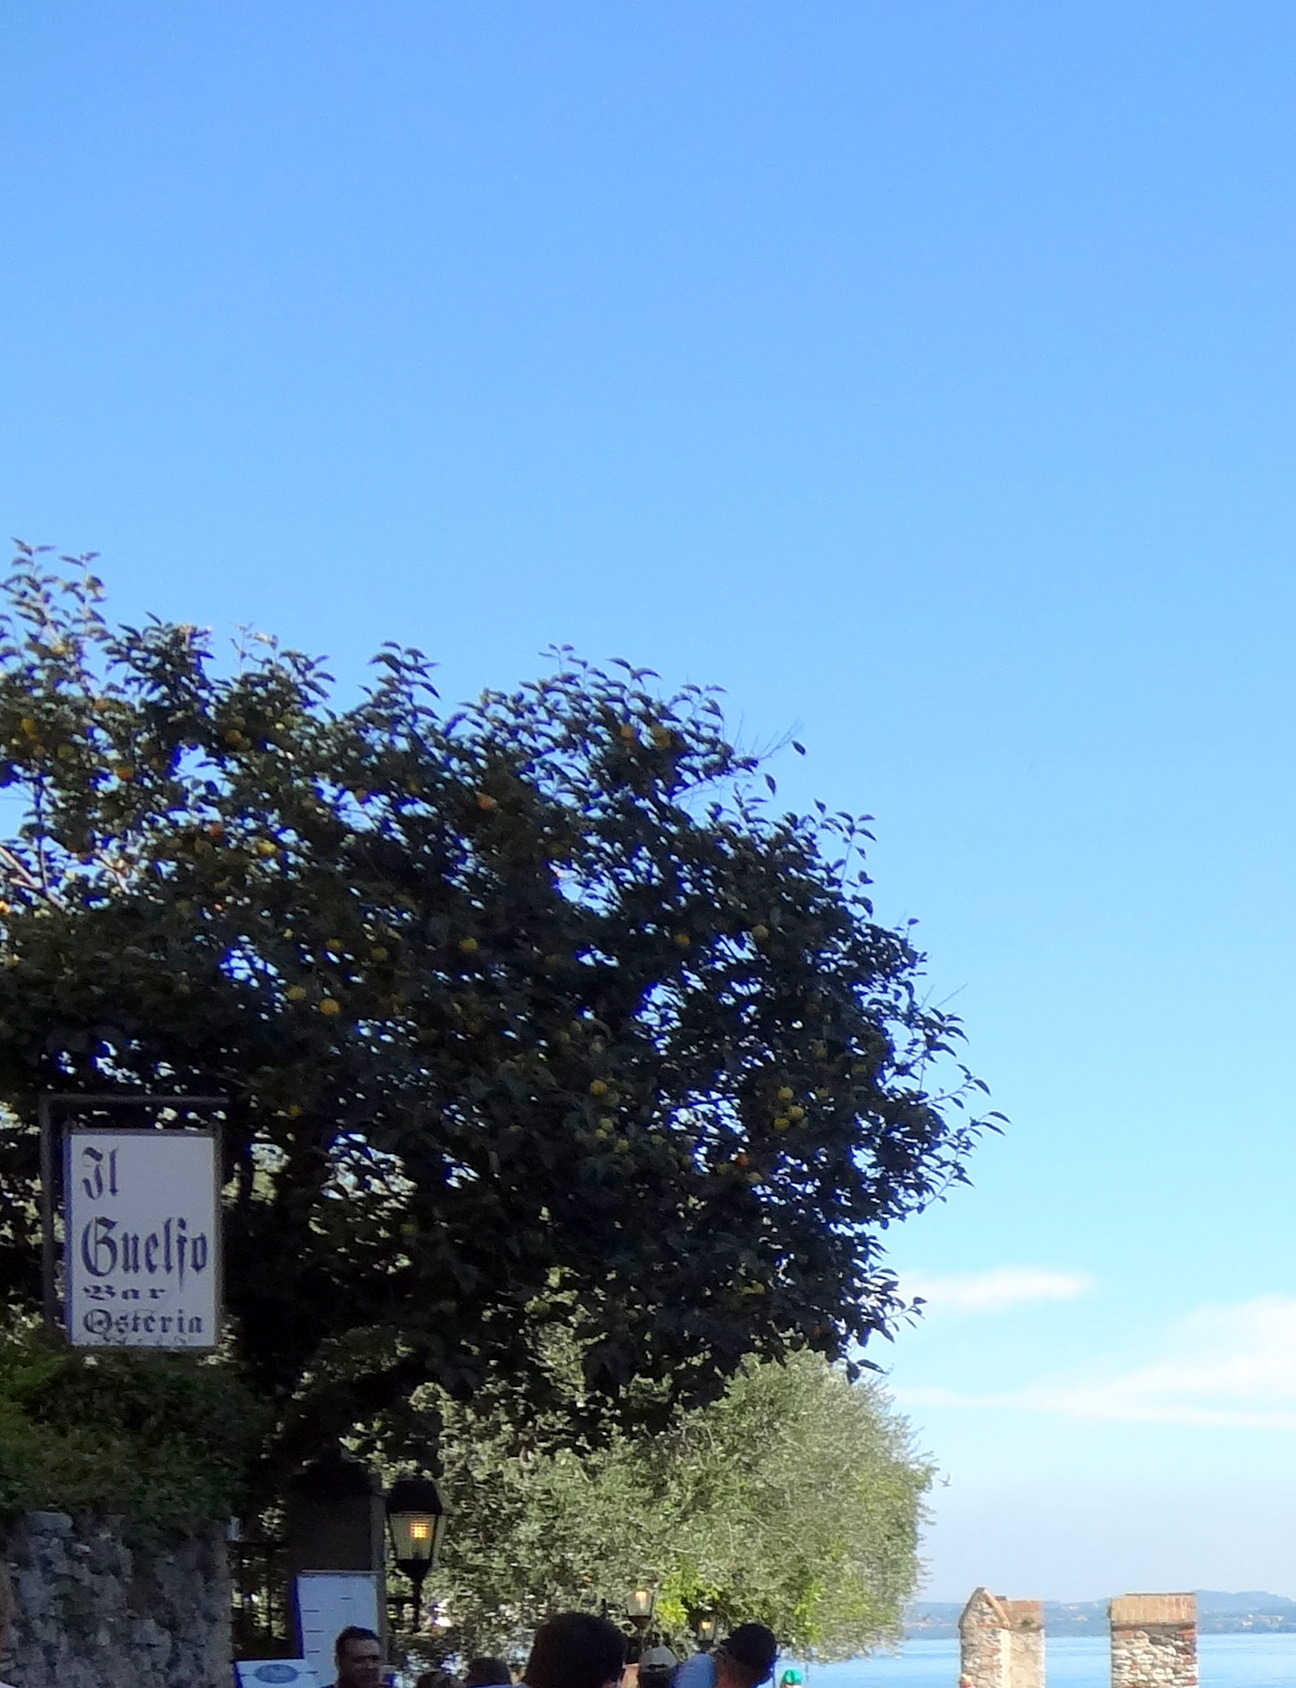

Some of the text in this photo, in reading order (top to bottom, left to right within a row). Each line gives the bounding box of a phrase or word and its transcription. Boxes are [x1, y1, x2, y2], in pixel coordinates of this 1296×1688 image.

[82, 1146, 119, 1200] Il
[81, 1216, 208, 1292] Guelfo
[82, 1284, 166, 1301] Bar
[83, 1308, 203, 1335] Osteria
